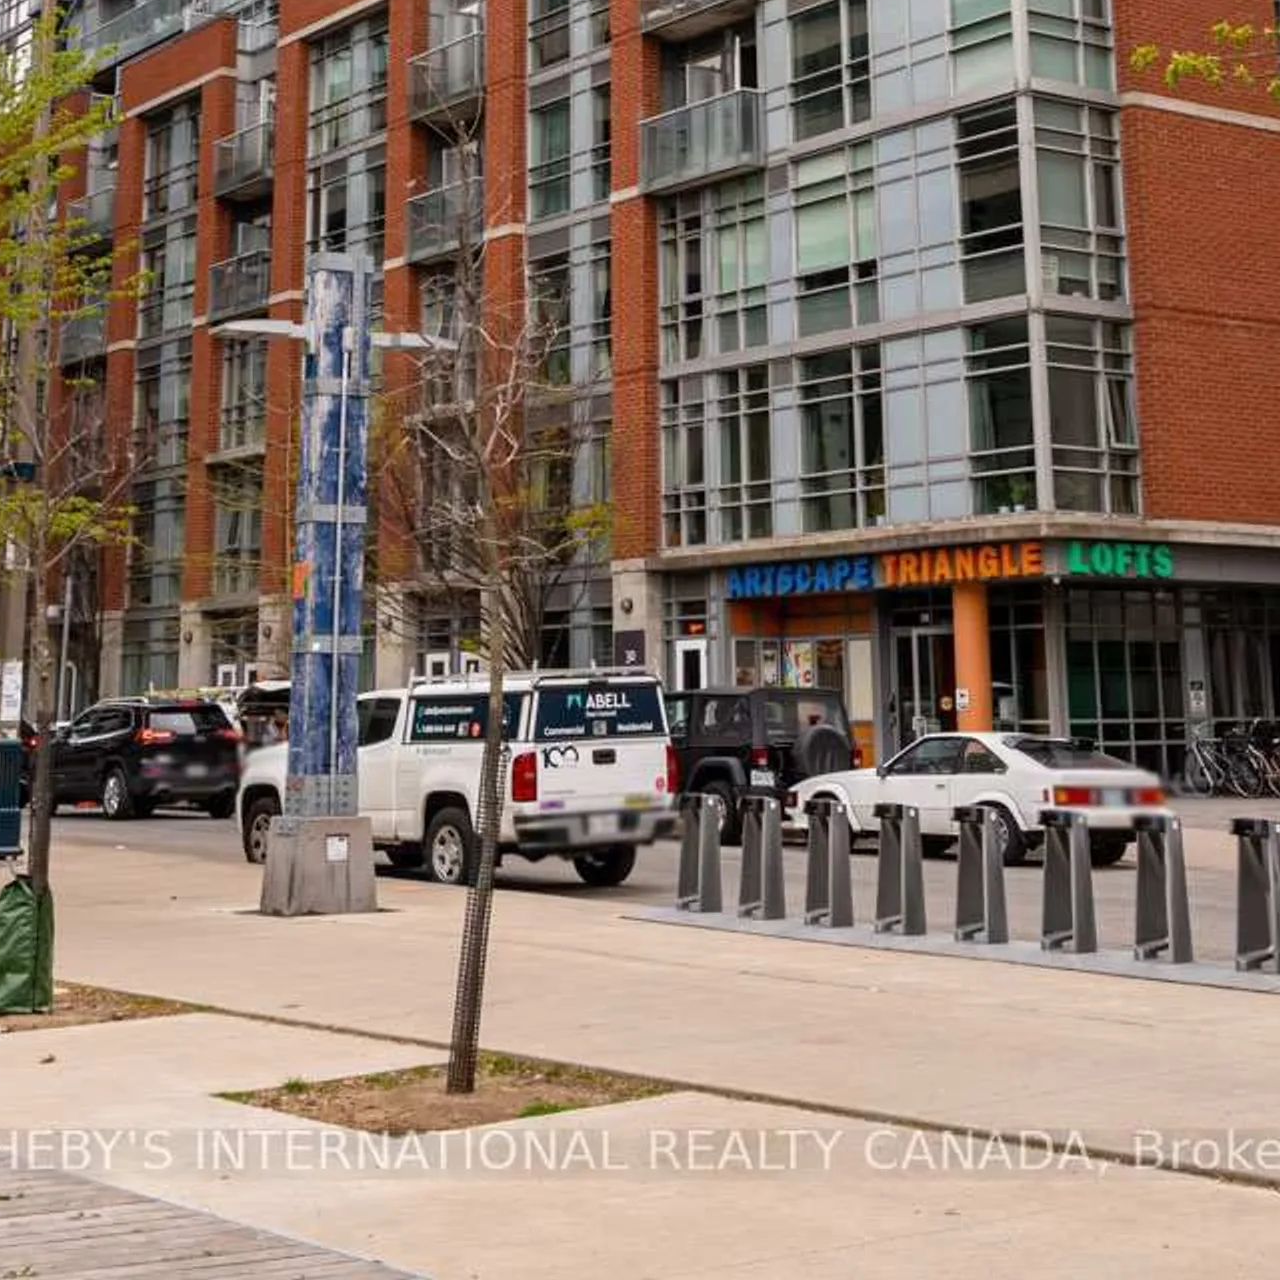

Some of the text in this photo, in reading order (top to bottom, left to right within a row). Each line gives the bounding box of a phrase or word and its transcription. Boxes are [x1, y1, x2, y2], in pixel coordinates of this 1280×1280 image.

[726, 540, 1173, 598] ARTSCAPE TRIANGLE LOFTS
[586, 692, 631, 709] ABELL
